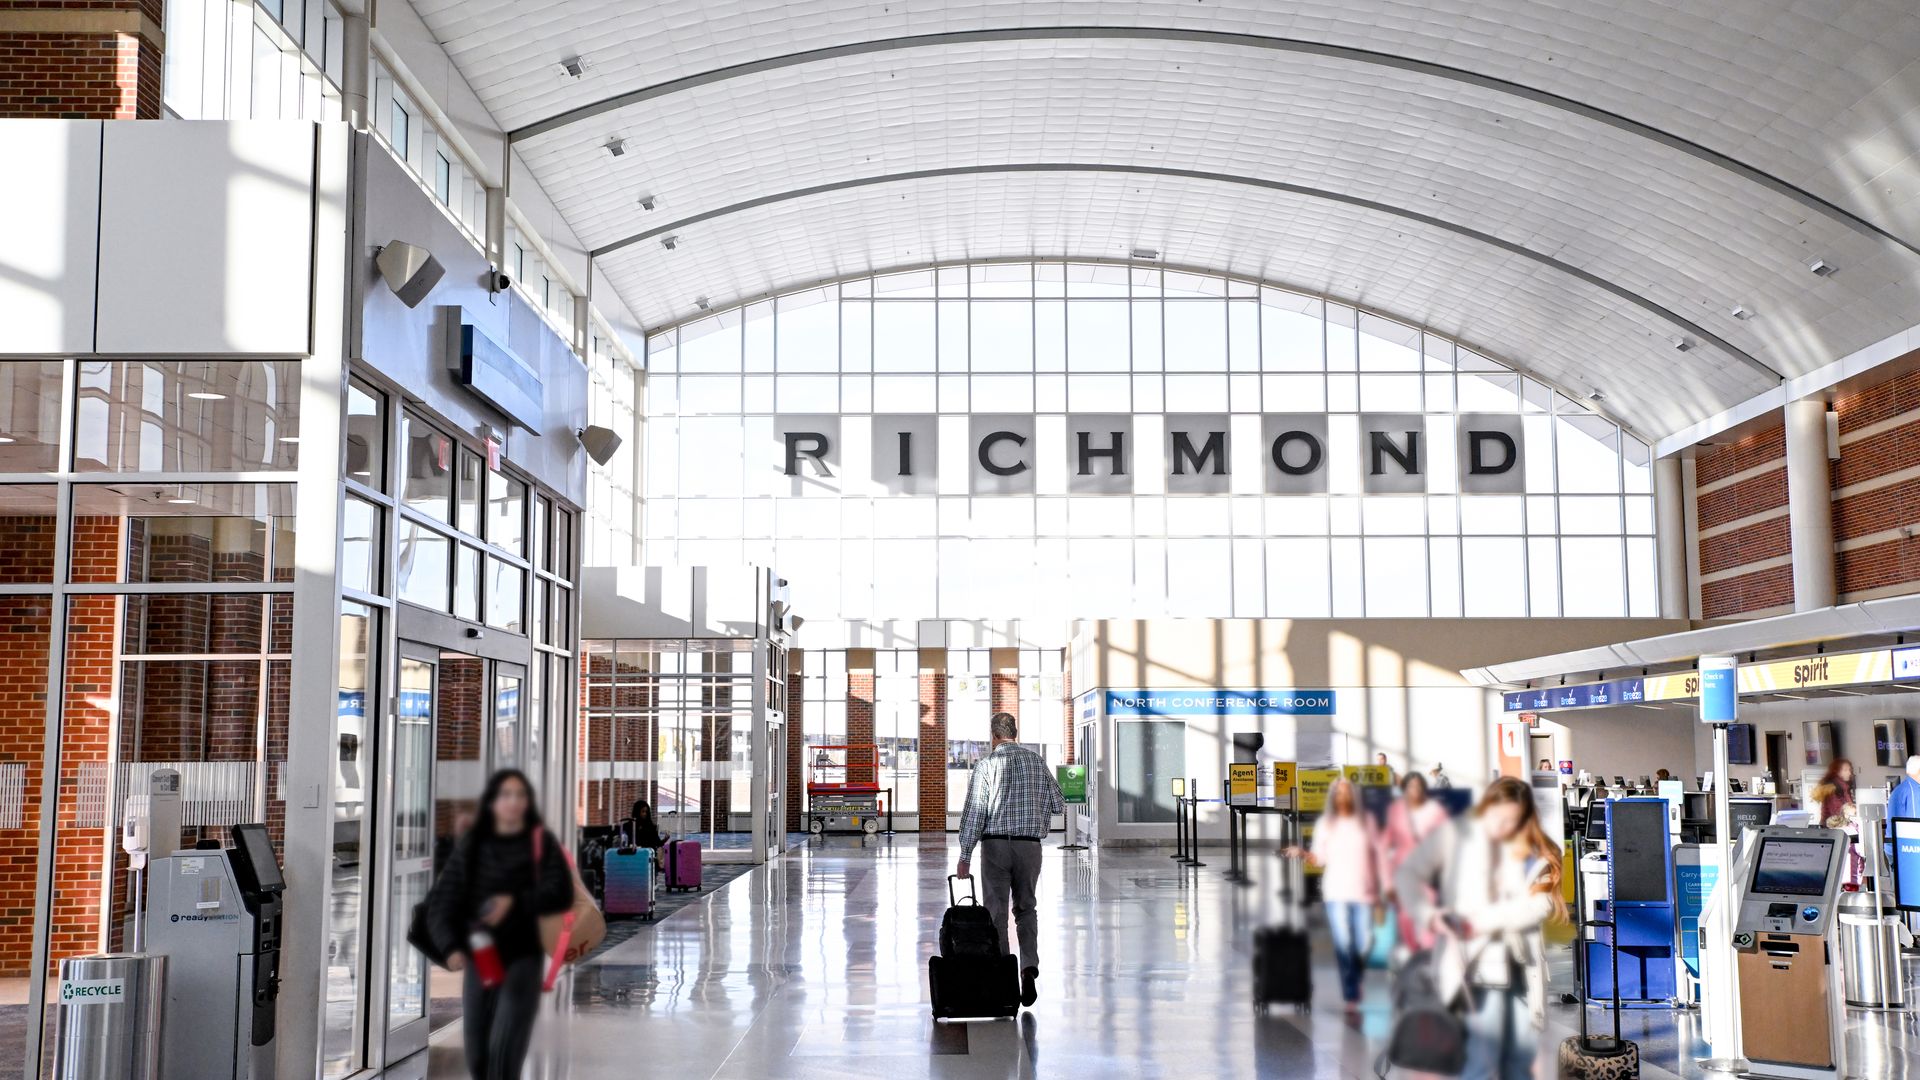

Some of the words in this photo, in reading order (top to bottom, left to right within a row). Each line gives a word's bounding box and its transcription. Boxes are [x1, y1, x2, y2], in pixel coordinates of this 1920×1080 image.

[783, 430, 1518, 476] RICHMOND
[1794, 656, 1829, 687] spirit
[1590, 694, 1607, 704] Breeze
[1623, 691, 1642, 700] Breeze
[1112, 698, 1166, 708] NORTH
[1171, 698, 1278, 708] CONFERENCE
[1283, 698, 1329, 708] ROOM
[1508, 731, 1515, 748] 1
[1877, 740, 1905, 750] Breeze
[1232, 769, 1254, 777] Agent
[1276, 768, 1287, 777] Bag
[75, 985, 121, 997] RECYCLE
